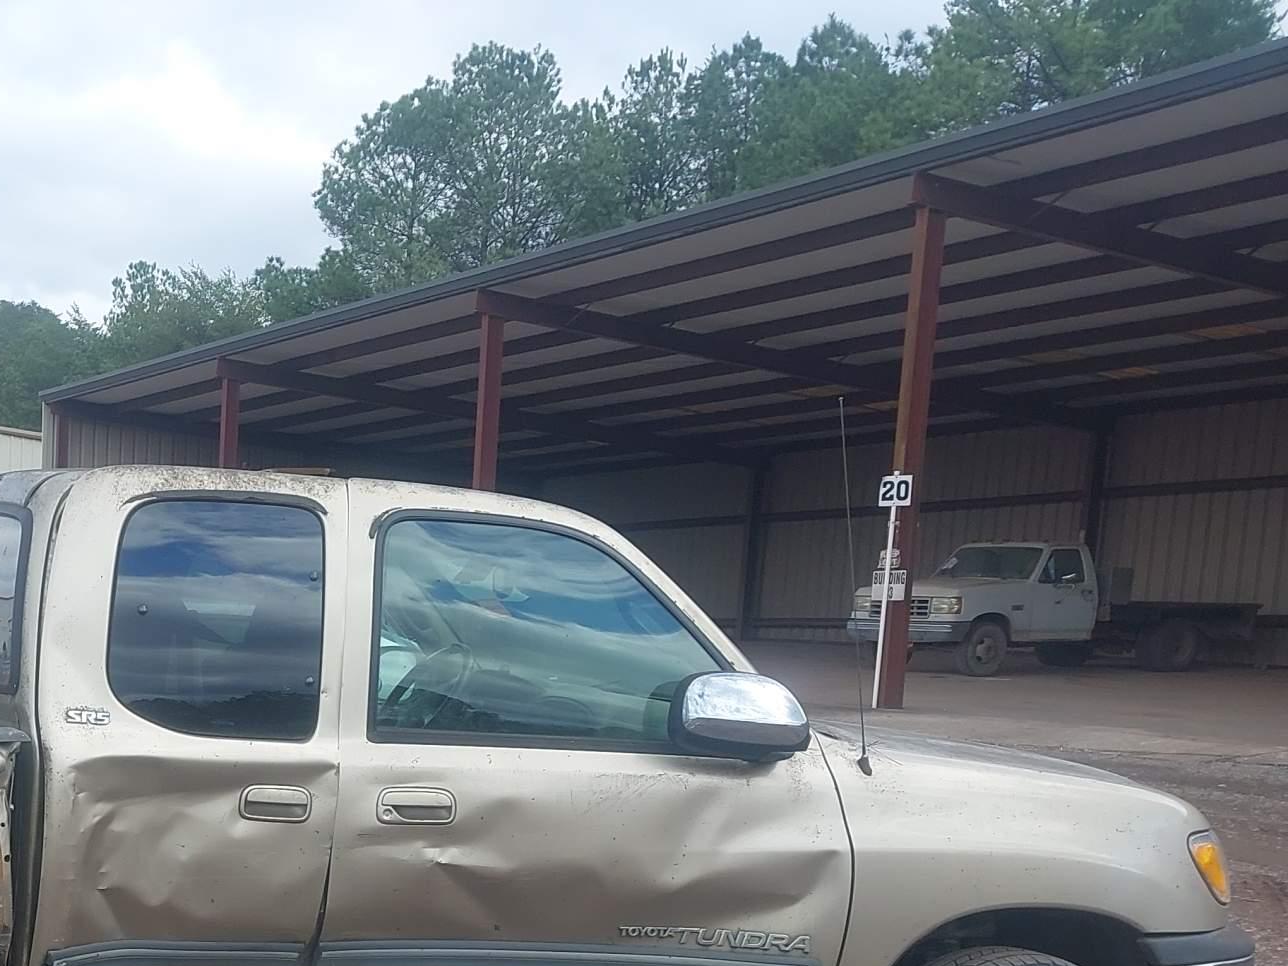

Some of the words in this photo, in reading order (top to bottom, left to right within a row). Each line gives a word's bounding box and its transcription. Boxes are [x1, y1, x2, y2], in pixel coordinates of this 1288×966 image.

[881, 480, 910, 502] 20
[873, 571, 906, 585] BUIDING
[618, 926, 676, 938] TOYOTA
[676, 927, 810, 954] TUNDRA
